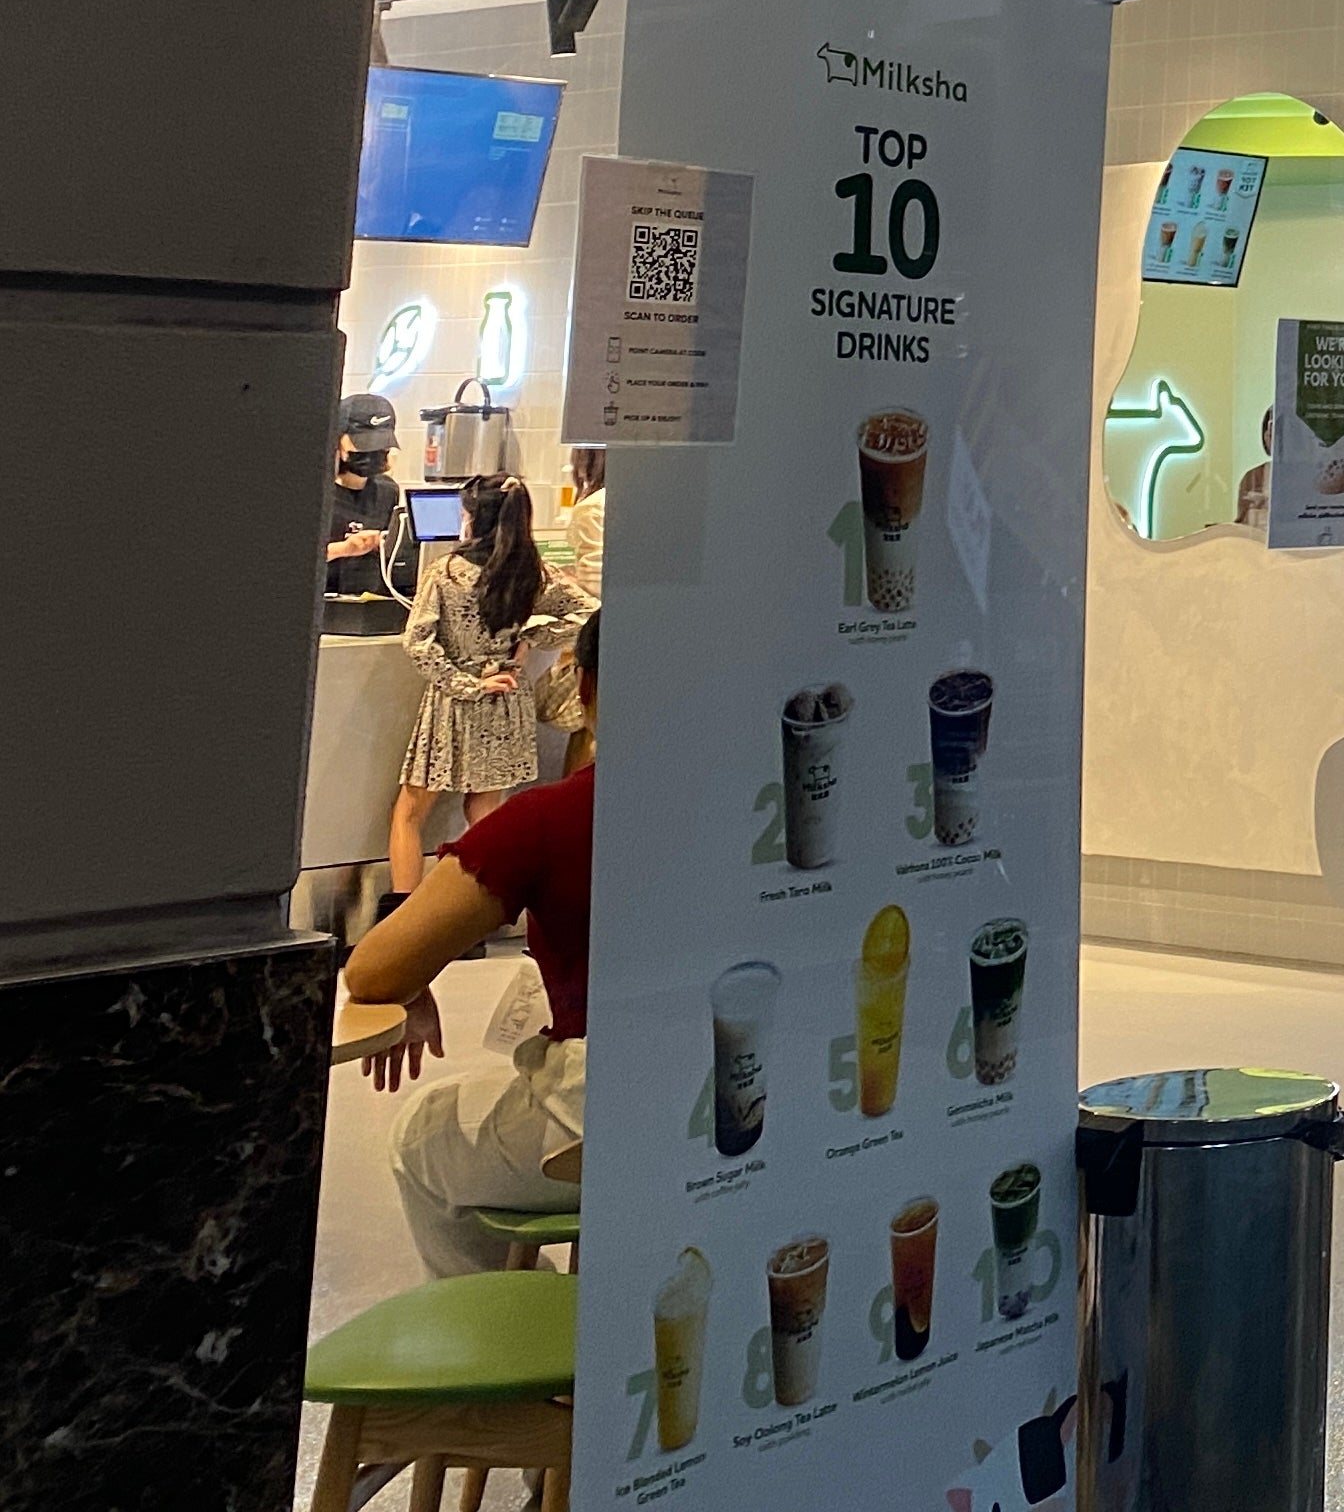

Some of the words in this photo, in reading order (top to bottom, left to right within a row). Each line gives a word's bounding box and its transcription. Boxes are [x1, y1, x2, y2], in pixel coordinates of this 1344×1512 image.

[861, 56, 968, 103] Milksha
[854, 124, 928, 170] TOP
[631, 206, 653, 216] SKIP
[655, 208, 672, 218] THE
[674, 209, 705, 220] QUEUE
[832, 172, 941, 281] 10
[623, 311, 651, 321] SCAN
[653, 313, 666, 322] TO
[668, 314, 700, 324] ORDER
[810, 287, 956, 326] SIGNATURE
[836, 330, 930, 365] DRINKS
[1303, 371, 1329, 387] FOR
